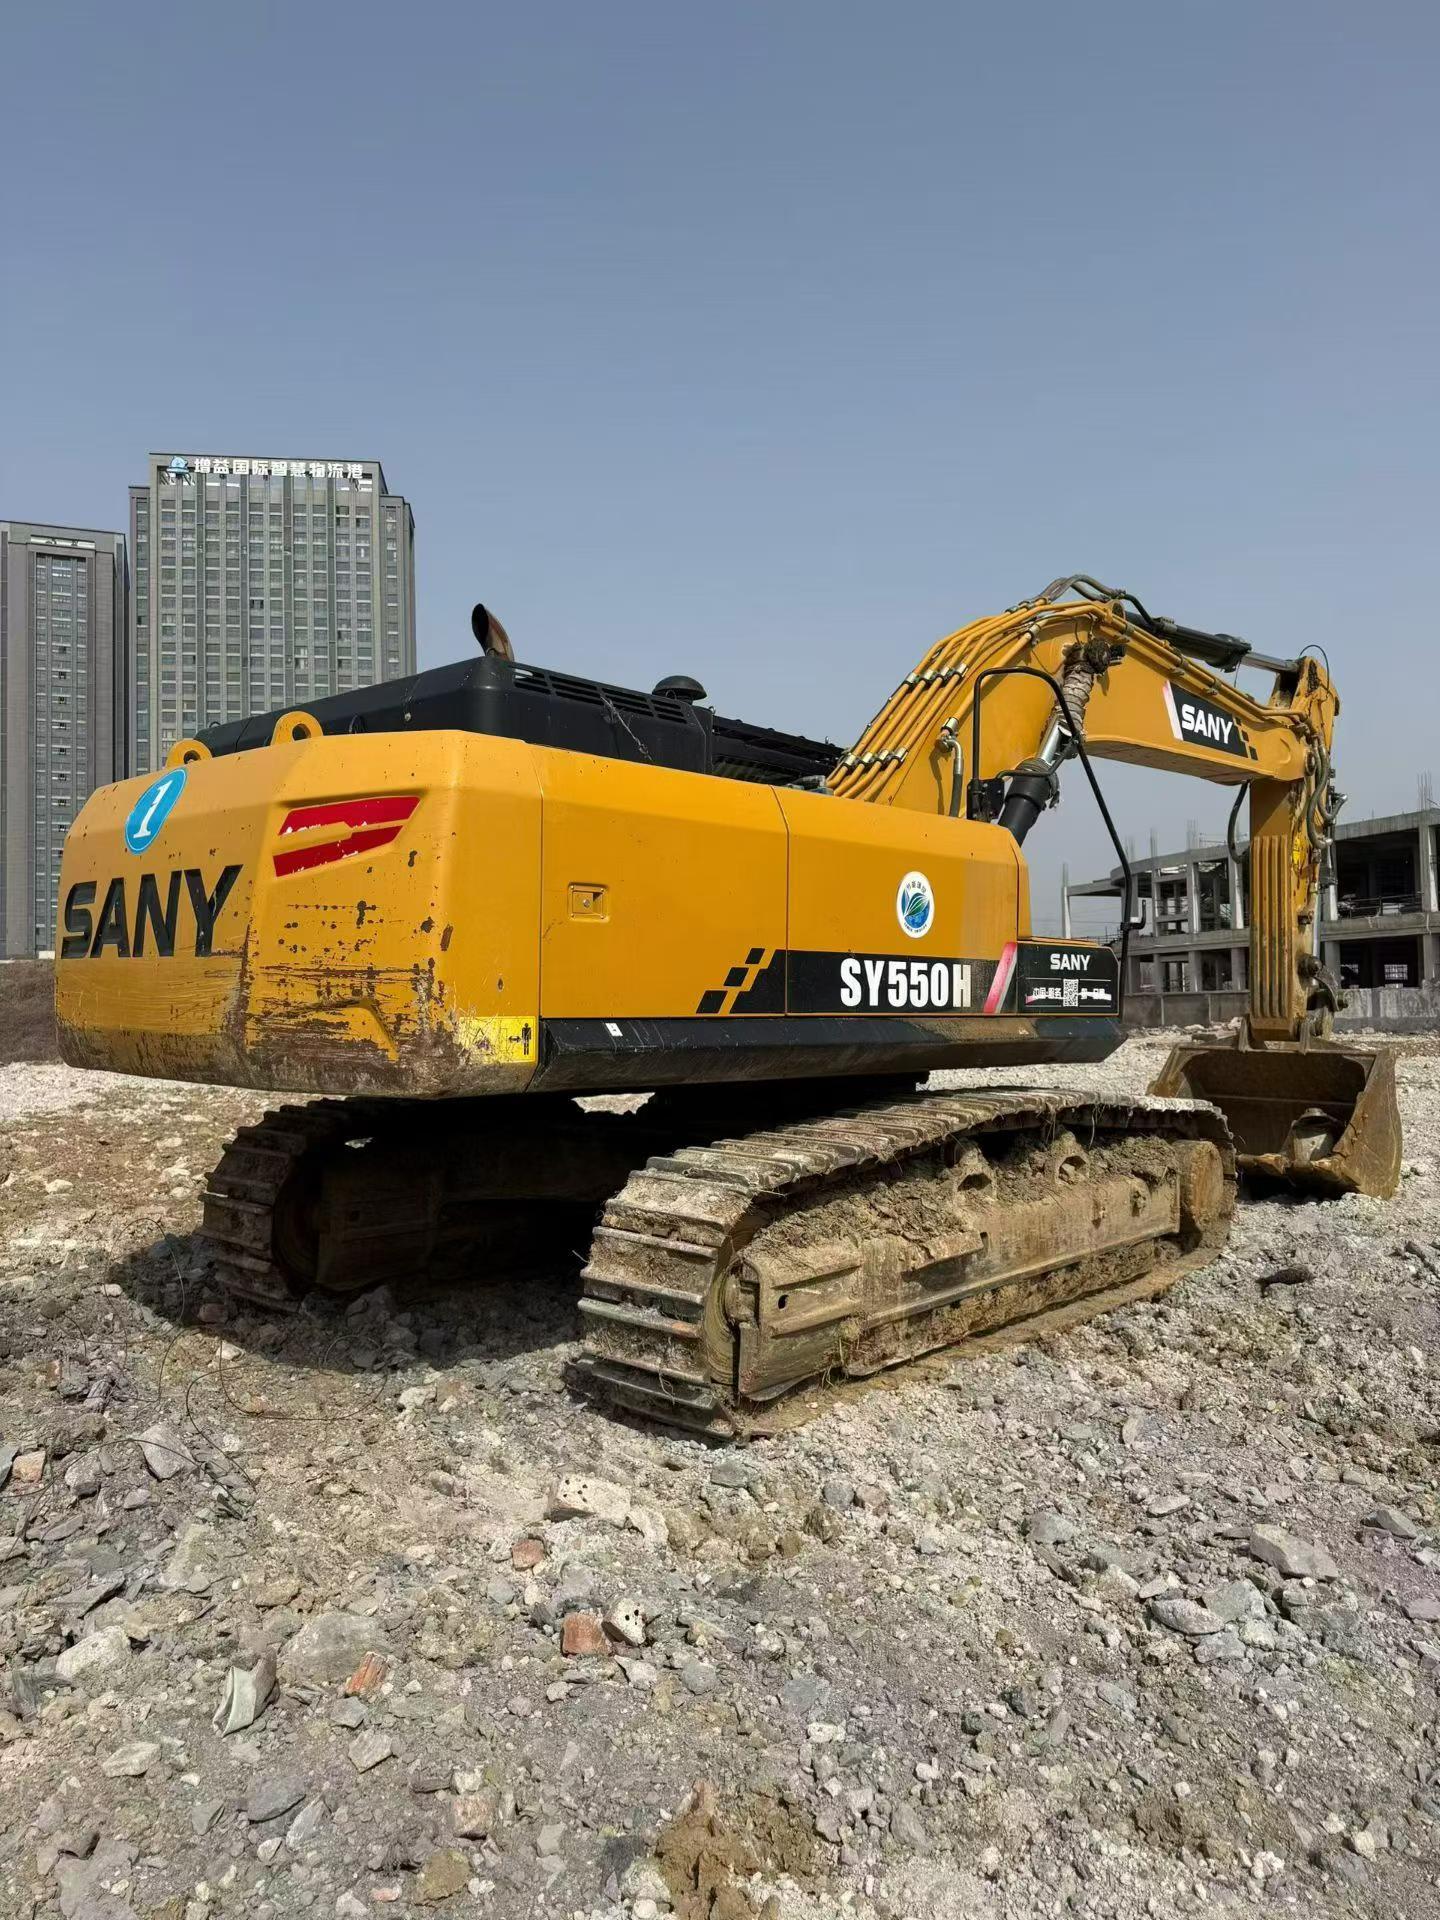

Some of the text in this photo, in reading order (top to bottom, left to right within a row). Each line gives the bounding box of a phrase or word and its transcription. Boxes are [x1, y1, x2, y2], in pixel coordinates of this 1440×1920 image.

[194, 458, 364, 479] 增益国际智慧物流港
[1181, 703, 1233, 744] SANY
[133, 779, 174, 839] 1
[61, 864, 243, 960] SANY
[840, 958, 972, 1009] SY550H
[1050, 953, 1091, 972] SANY
